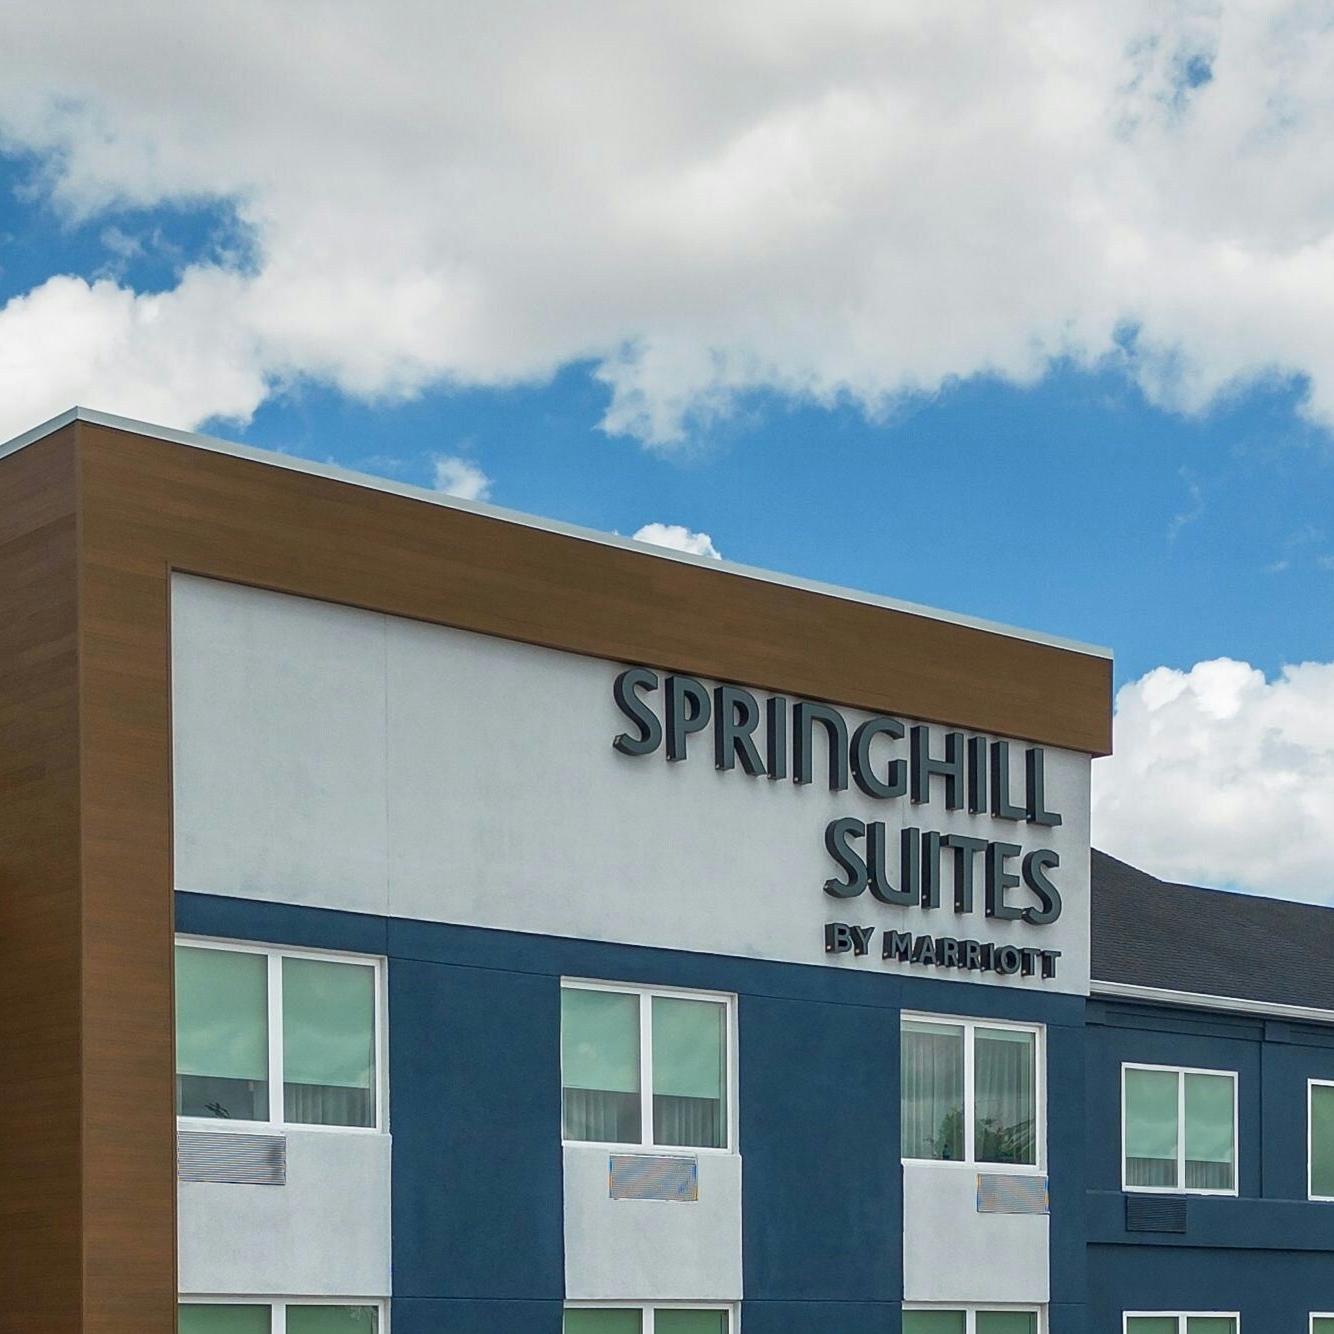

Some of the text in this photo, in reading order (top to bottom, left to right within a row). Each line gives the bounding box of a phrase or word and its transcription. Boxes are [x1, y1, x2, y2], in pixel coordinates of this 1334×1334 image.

[612, 668, 1062, 827] SPRINGHILL
[823, 816, 1062, 925] SUITES
[825, 922, 1062, 979] BY MARRIOTT
